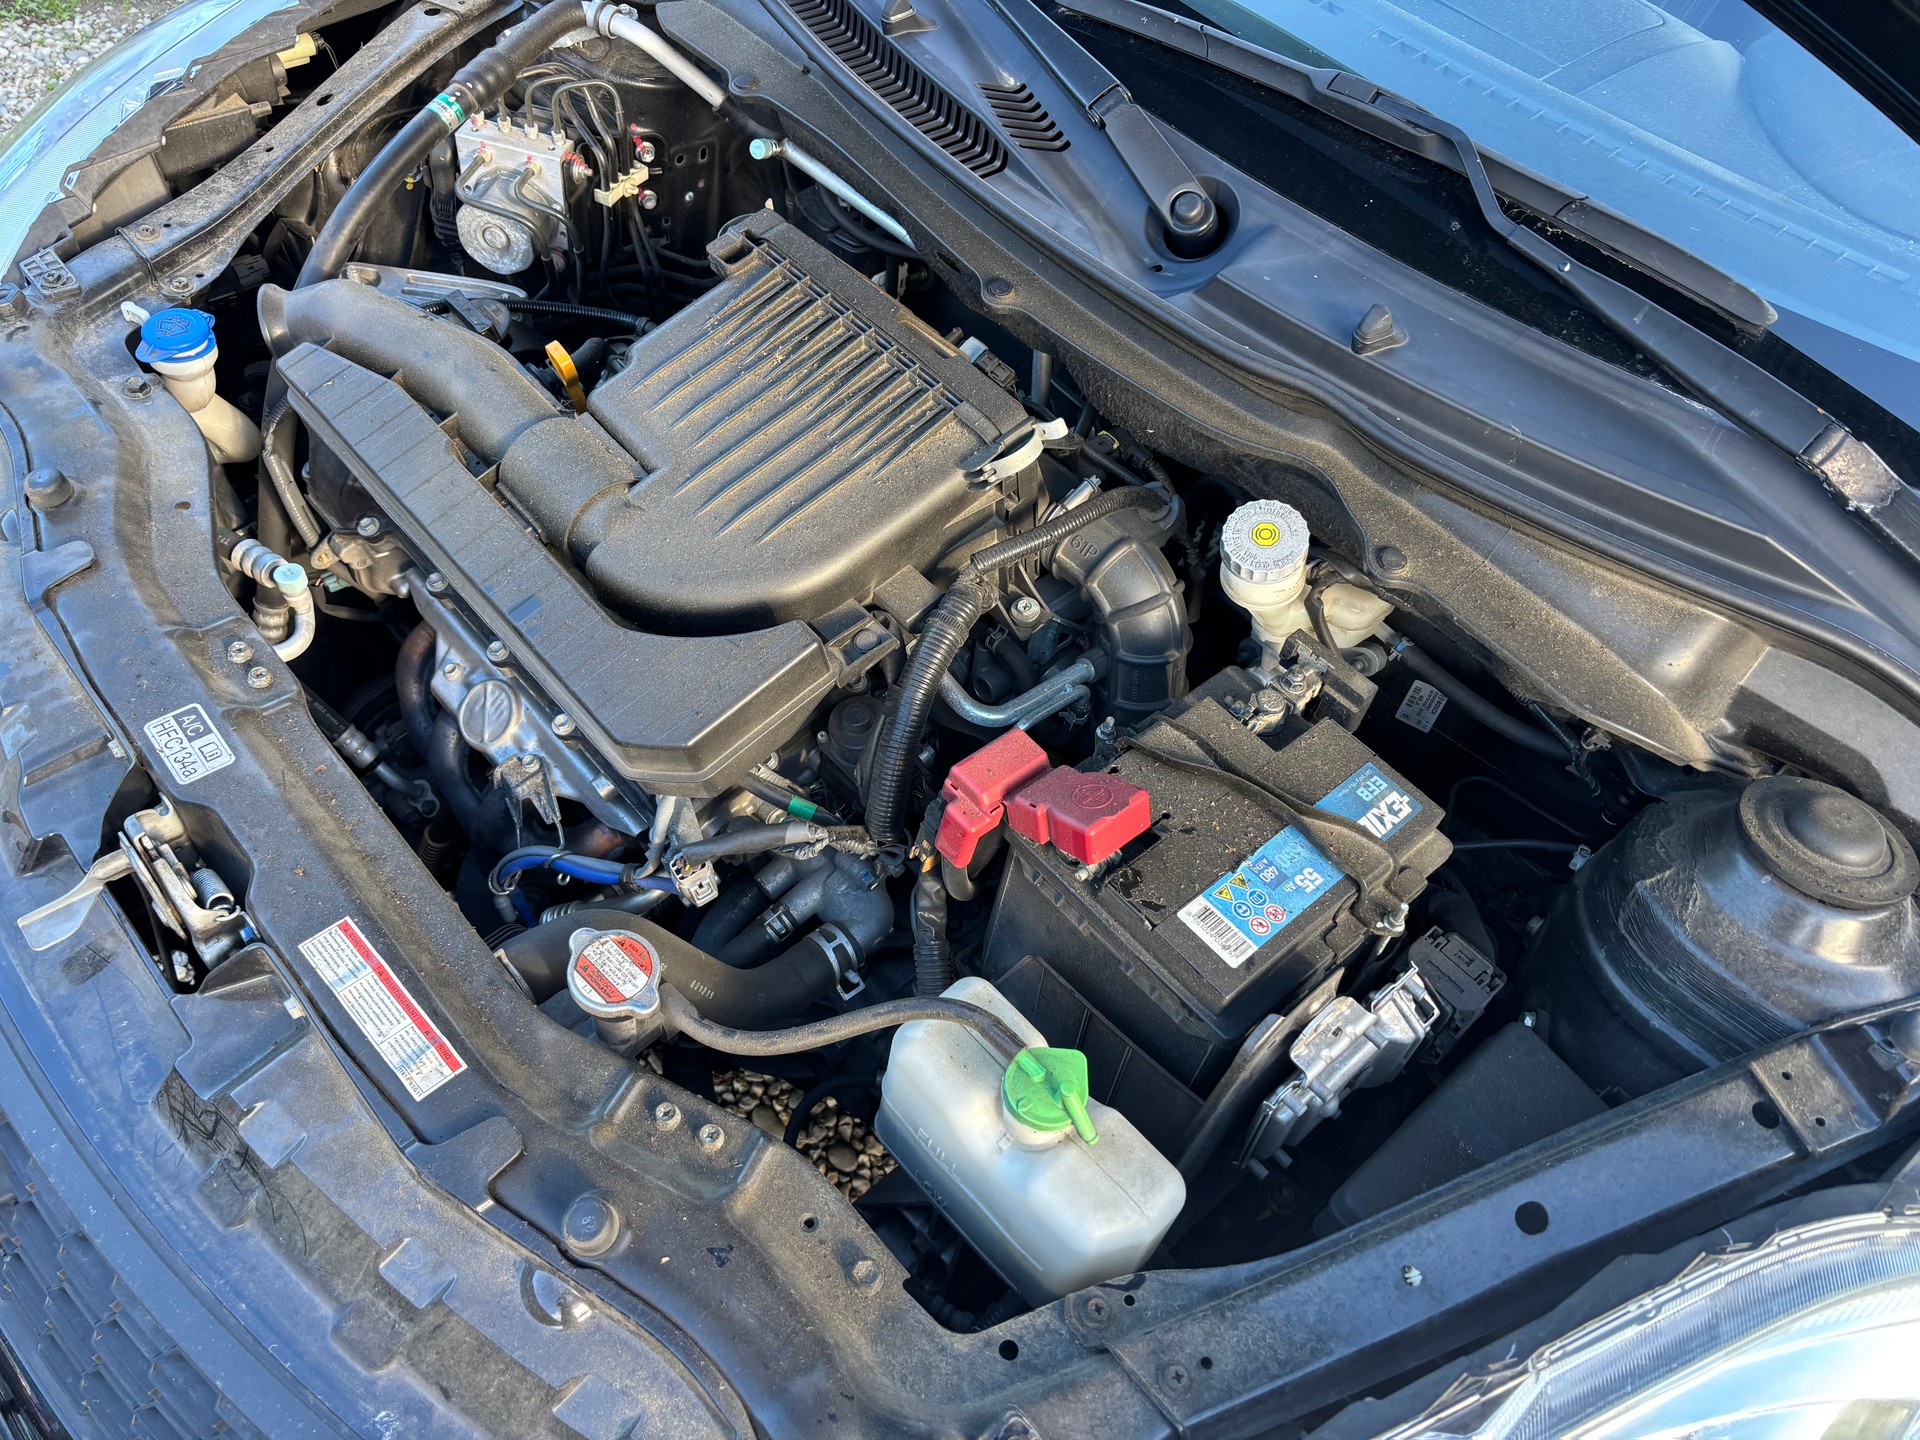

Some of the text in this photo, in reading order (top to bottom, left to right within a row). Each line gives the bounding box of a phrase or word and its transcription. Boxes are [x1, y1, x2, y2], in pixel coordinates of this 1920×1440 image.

[1070, 534, 1099, 559] 61P
[179, 715, 204, 735] A/C
[153, 720, 197, 778] HFC134a
[1355, 775, 1388, 801] EFB
[1356, 790, 1413, 838] EXI
[1258, 864, 1279, 883] 480
[1281, 864, 1324, 893] 55 Ah
[383, 976, 417, 1018] AVERTISSEMENT
[917, 1127, 961, 1181] FULL
